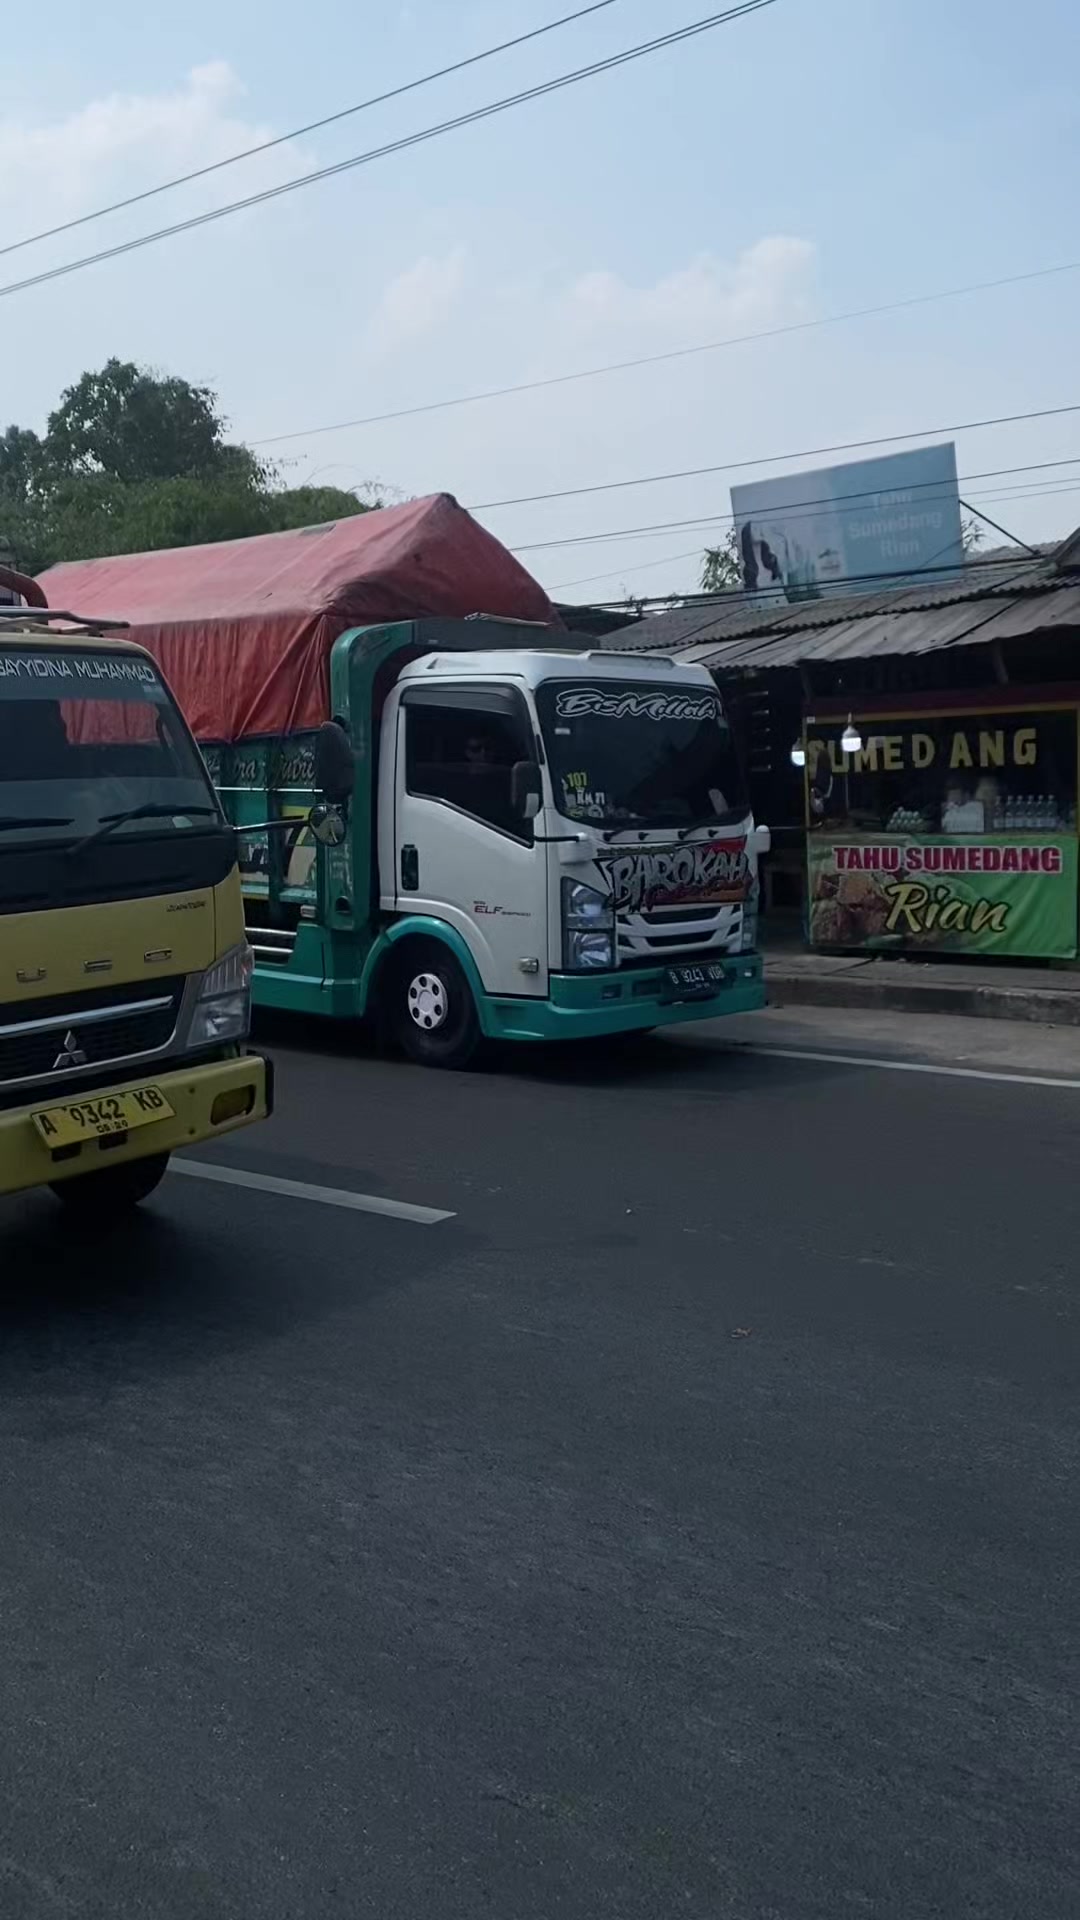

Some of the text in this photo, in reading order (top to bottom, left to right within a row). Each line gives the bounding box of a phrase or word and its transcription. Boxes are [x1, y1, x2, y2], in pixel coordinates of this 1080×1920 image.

[74, 660, 156, 683] MUHAMMAD
[567, 772, 587, 787] 107
[833, 845, 1063, 873] TAHU SUMEDANG
[474, 905, 503, 915] ELF
[884, 881, 1012, 934] Rian
[39, 1089, 164, 1136] A 9342 KB
